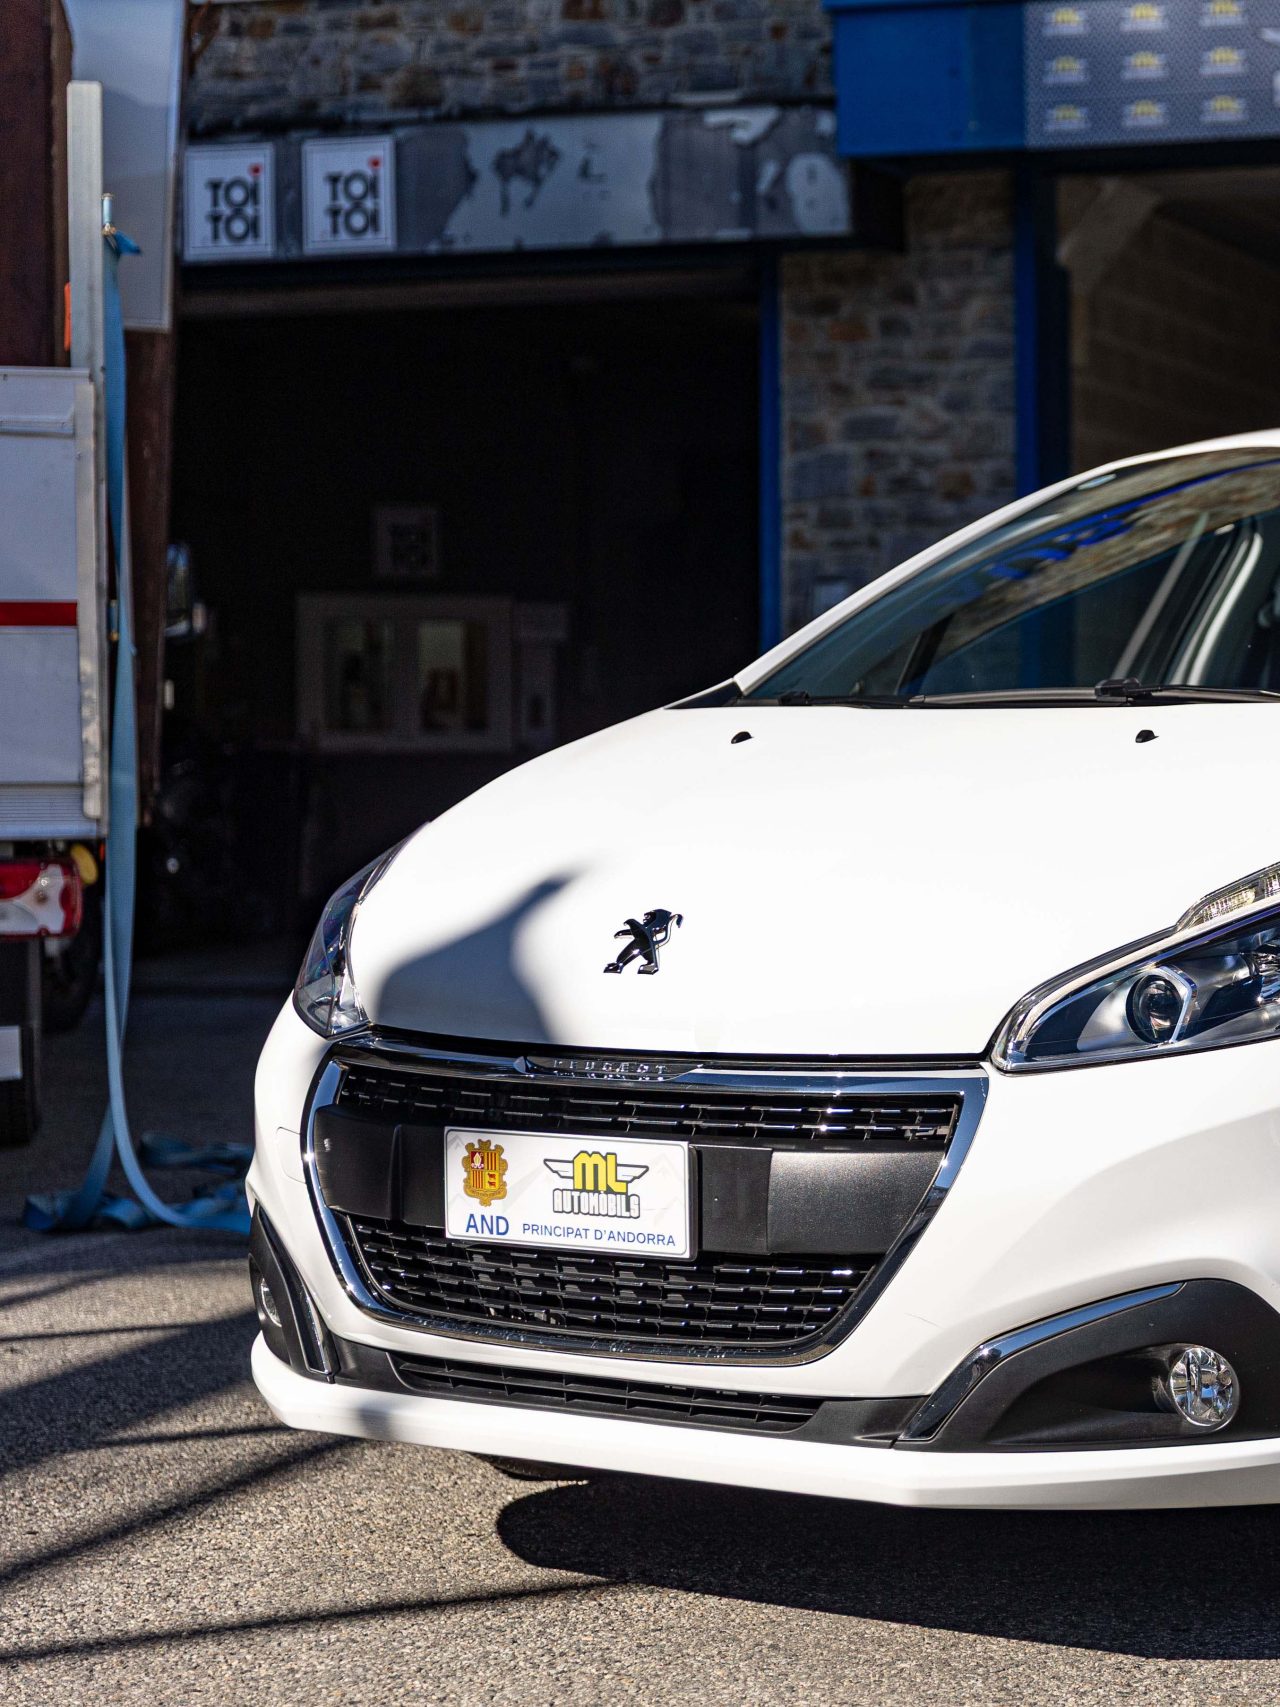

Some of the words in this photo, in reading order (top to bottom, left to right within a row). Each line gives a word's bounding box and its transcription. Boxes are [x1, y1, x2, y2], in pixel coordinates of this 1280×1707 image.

[573, 1151, 628, 1193] ML
[465, 1213, 509, 1236] AND
[522, 1223, 589, 1240] PRINCIPAT
[594, 1230, 676, 1247] D'ANDORRA
